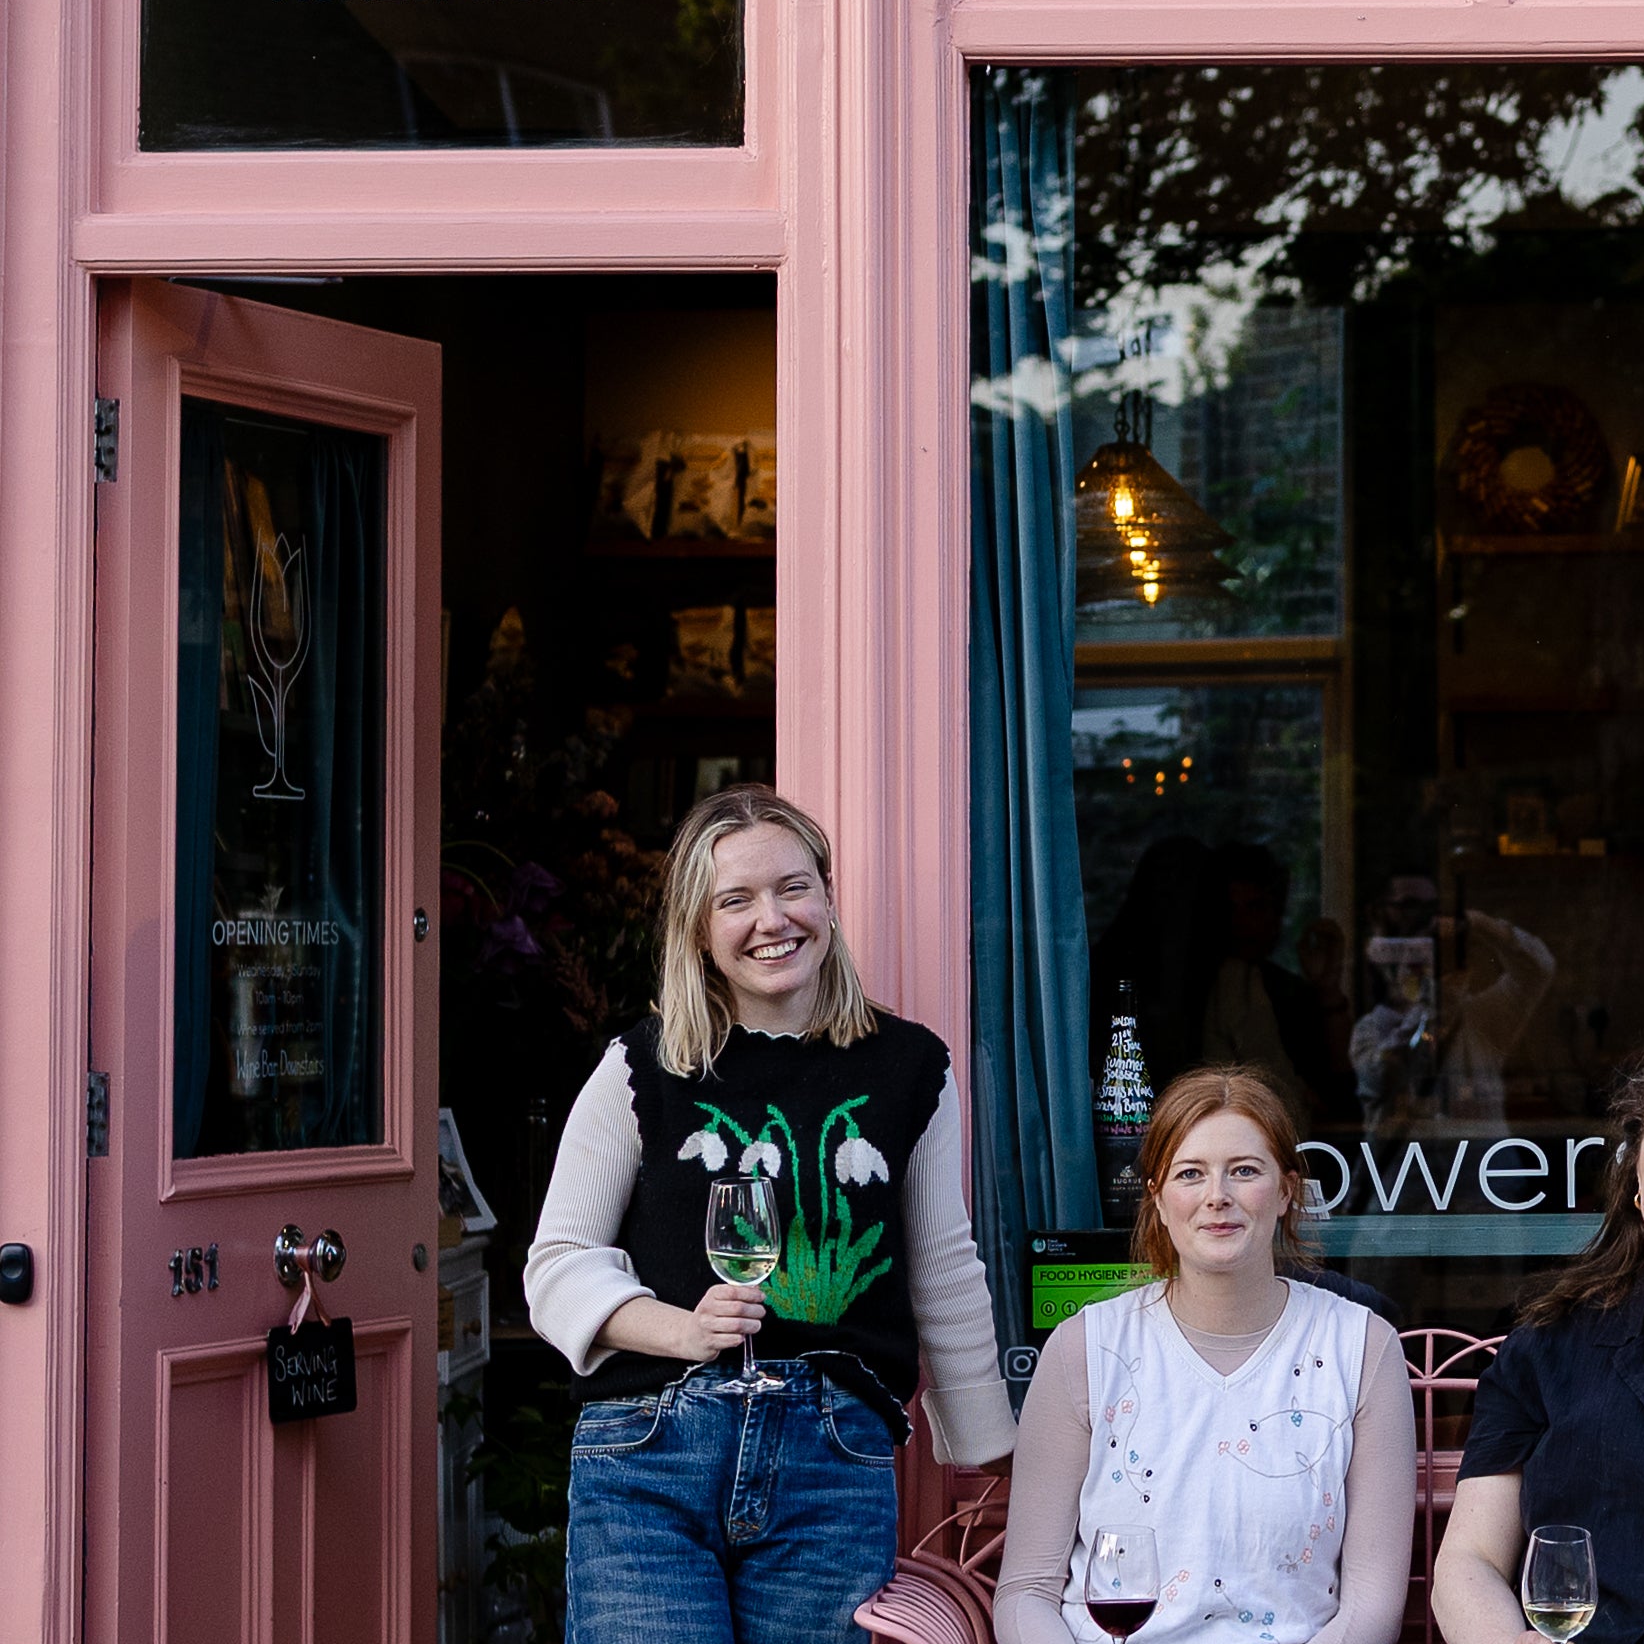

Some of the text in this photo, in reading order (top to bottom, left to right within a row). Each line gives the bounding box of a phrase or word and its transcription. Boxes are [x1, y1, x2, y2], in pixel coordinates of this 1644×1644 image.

[212, 920, 339, 946] OPENING TIMES
[237, 964, 285, 978] Wednesday
[292, 964, 321, 979] Sunday
[256, 991, 275, 1005] 10am
[283, 990, 304, 1005] 10pm
[236, 1049, 324, 1080] Wine Bar Downstairs
[168, 1242, 220, 1298] 151
[1040, 1269, 1076, 1281] FOOD
[1078, 1268, 1128, 1280] HYGIENE
[275, 1345, 338, 1382] SERVING
[292, 1378, 338, 1406] WINE
